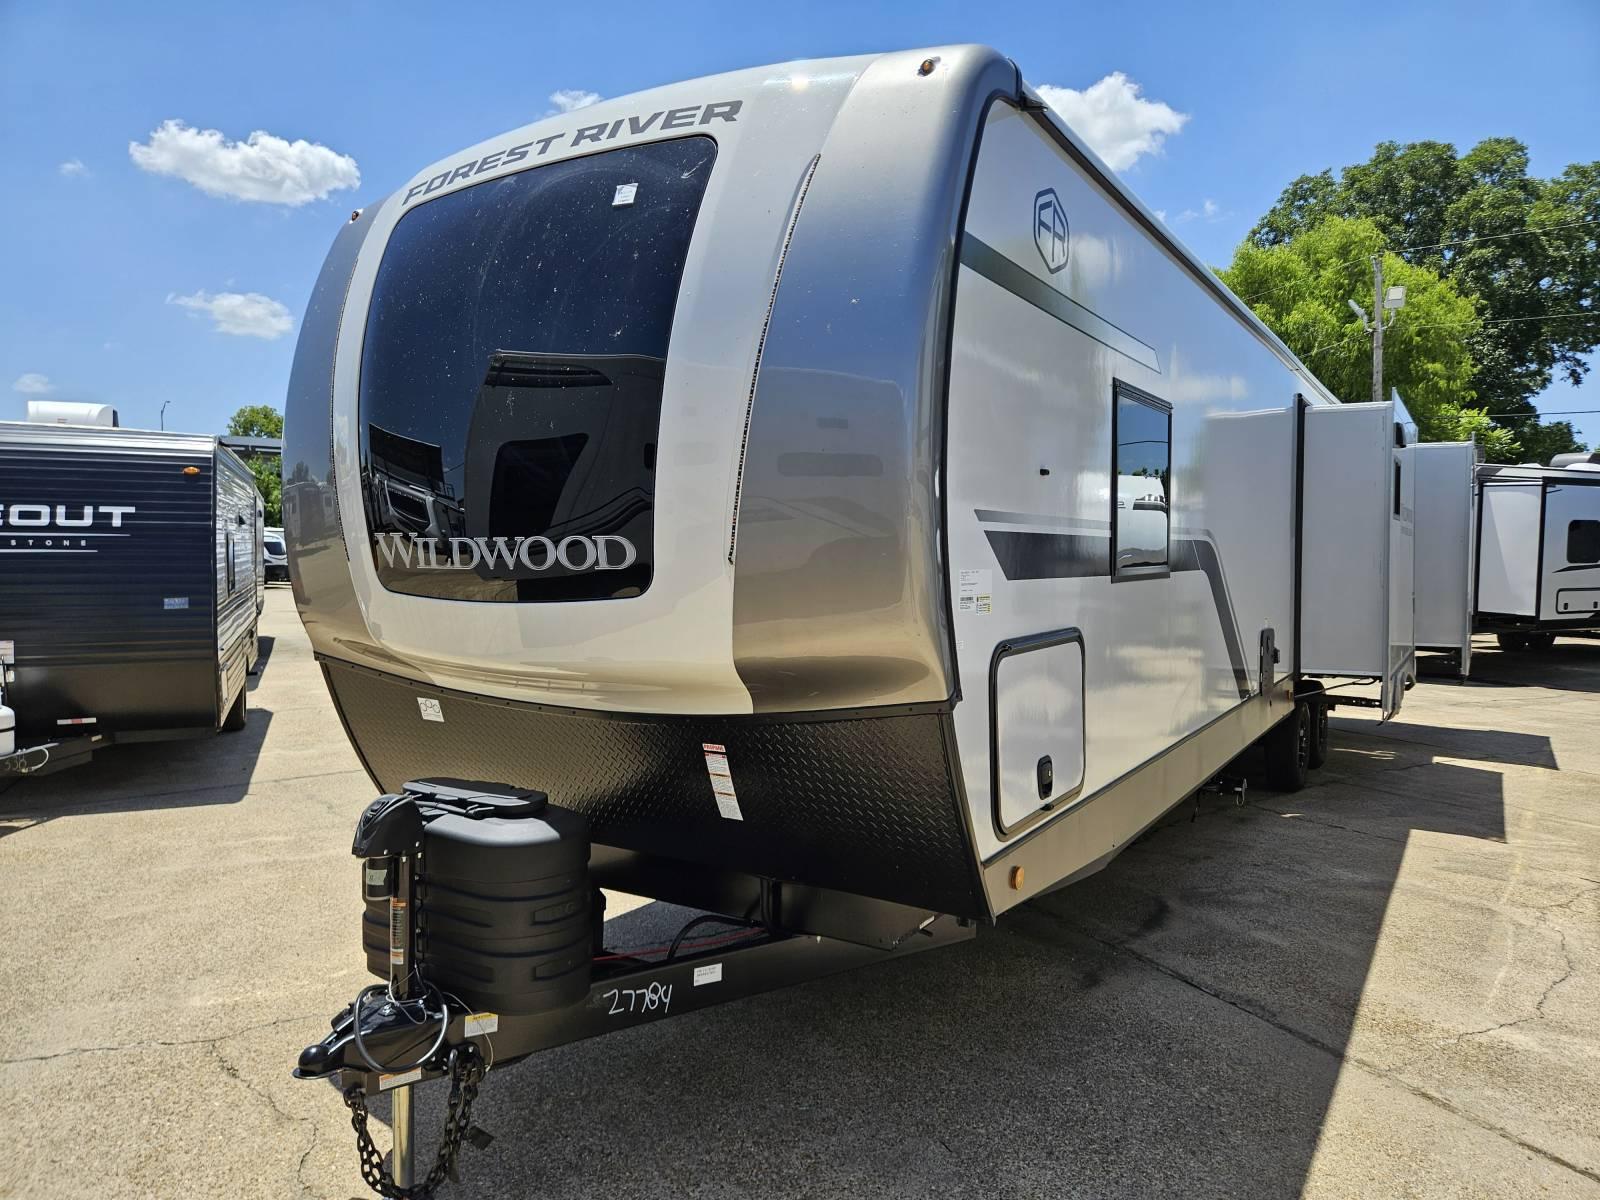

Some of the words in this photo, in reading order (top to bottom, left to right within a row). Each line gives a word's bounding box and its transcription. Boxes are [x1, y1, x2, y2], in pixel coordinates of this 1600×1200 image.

[401, 132, 565, 207] FOREST
[570, 100, 743, 148] RIVER
[0, 504, 136, 527] OUT
